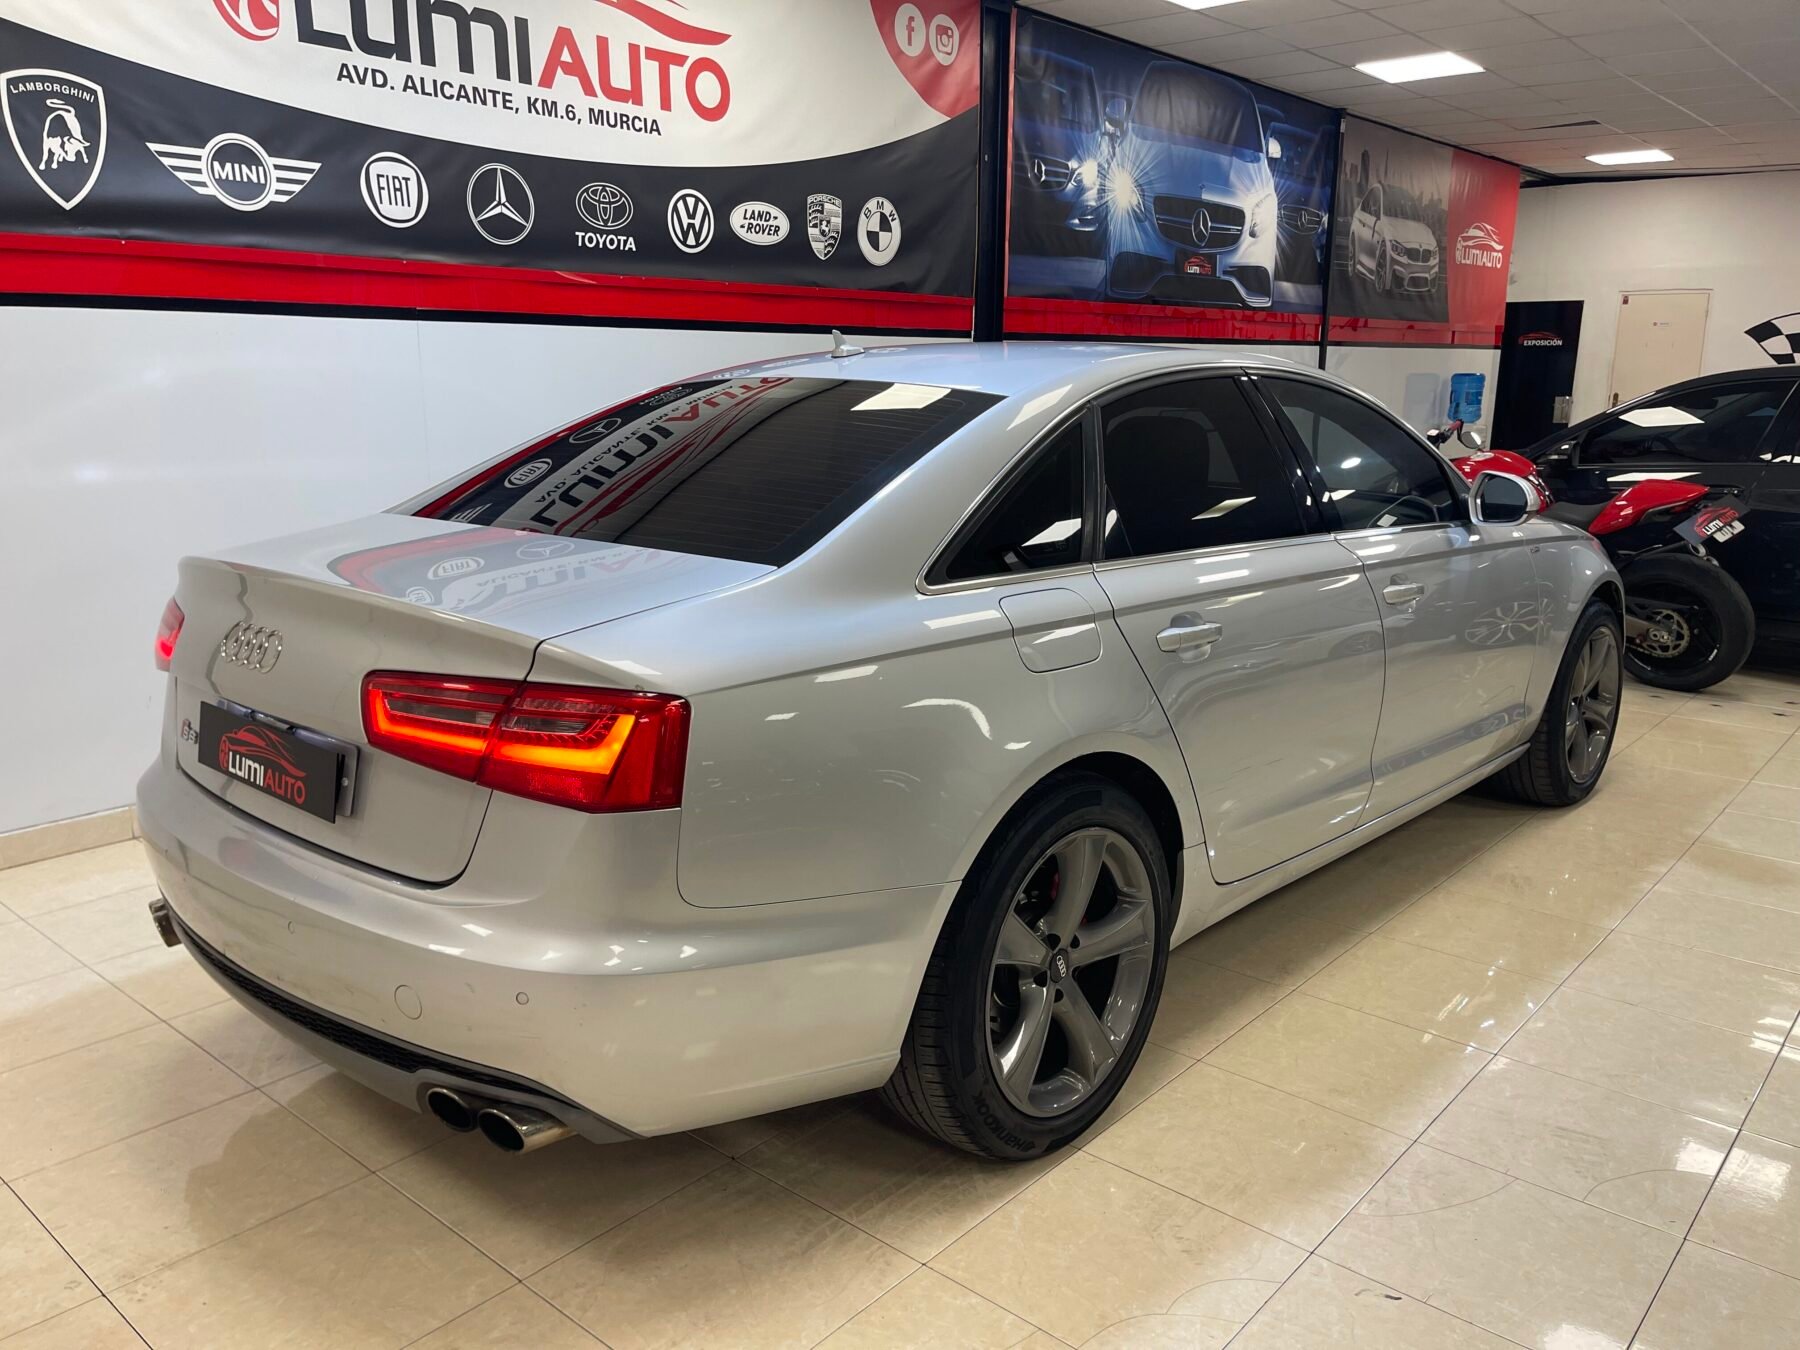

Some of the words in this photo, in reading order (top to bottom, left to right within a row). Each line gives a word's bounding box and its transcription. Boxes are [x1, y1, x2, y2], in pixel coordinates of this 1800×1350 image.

[10, 82, 95, 103] LAMBORGHINI
[337, 62, 395, 91] AVD.
[402, 74, 520, 115] ALICANTE,
[526, 95, 582, 126] KM.6,
[588, 107, 662, 136] MURCIA
[213, 161, 266, 184] MINI
[376, 173, 411, 208] FIAT
[809, 194, 841, 207] PORSCHE
[863, 200, 897, 223] BMW
[575, 231, 637, 251] TOYOTA
[1523, 338, 1563, 346] EXPOSICIÓN
[228, 751, 306, 805] LUMIAUTO
